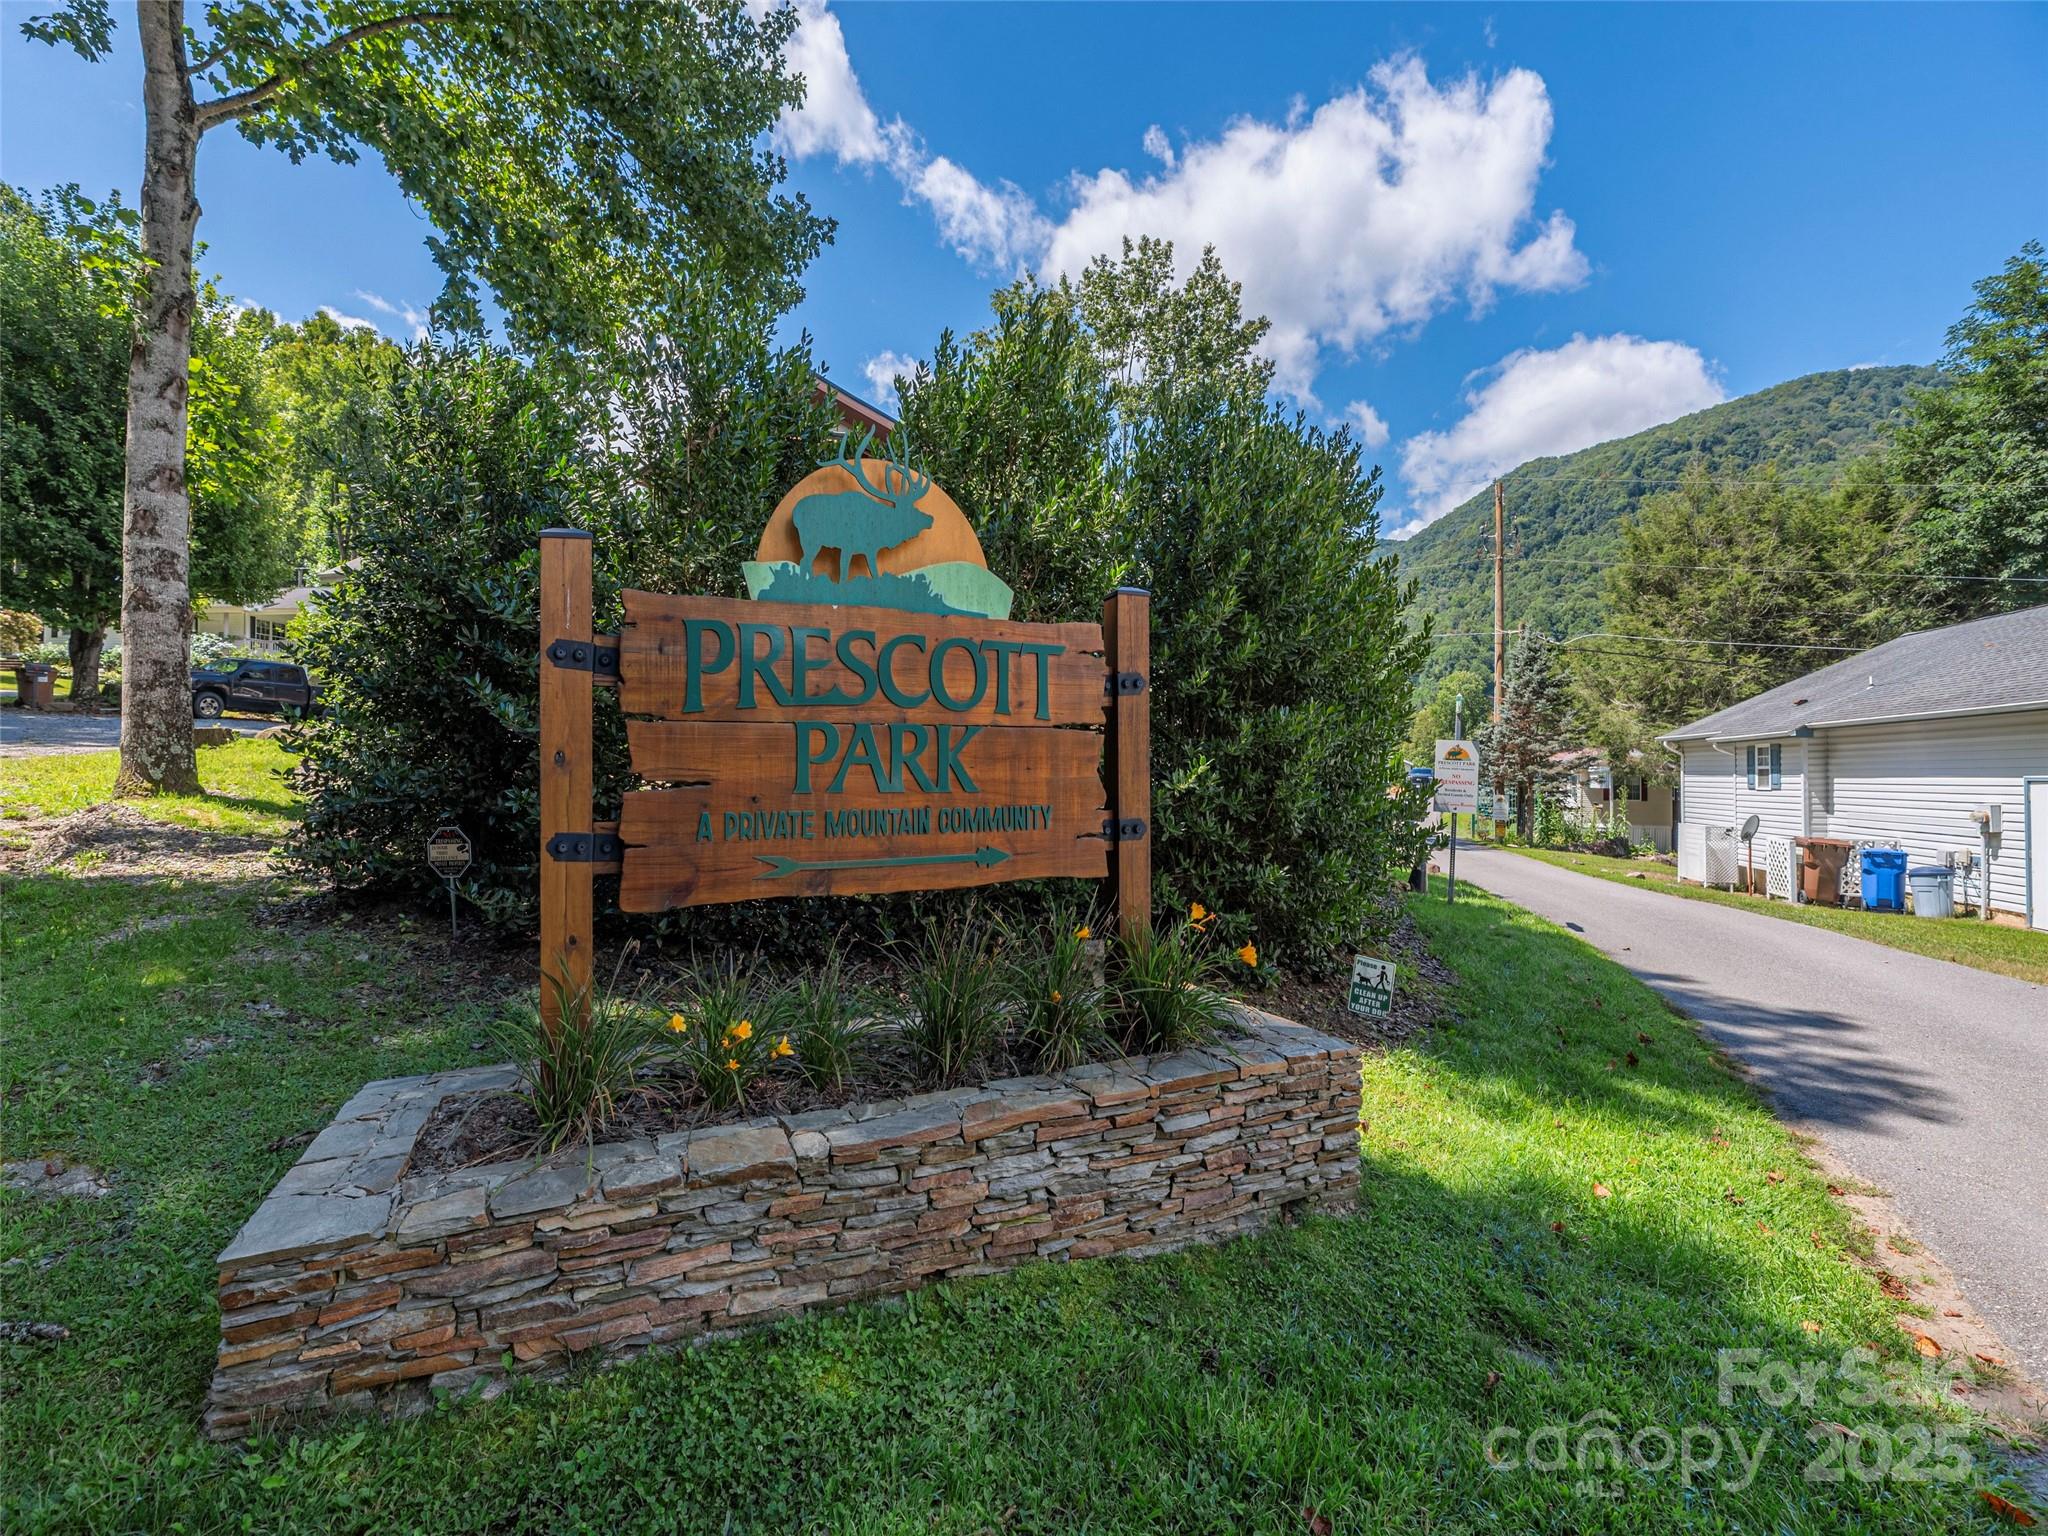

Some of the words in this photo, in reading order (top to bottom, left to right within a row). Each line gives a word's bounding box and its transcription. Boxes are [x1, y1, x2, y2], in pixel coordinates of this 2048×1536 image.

[682, 618, 1067, 721] PRESCOTT
[793, 720, 985, 795] PARK
[696, 811, 713, 842] A
[723, 810, 815, 842] PRIVATE
[824, 806, 932, 839] MOUNTAIN
[938, 804, 1053, 833] COMMUNITY
[1357, 959, 1377, 970] Please
[1354, 988, 1377, 999] CLEAN
[1351, 1002, 1370, 1013] YOUR
[1372, 1008, 1387, 1017] DOG
[1359, 997, 1381, 1008] AFTER
